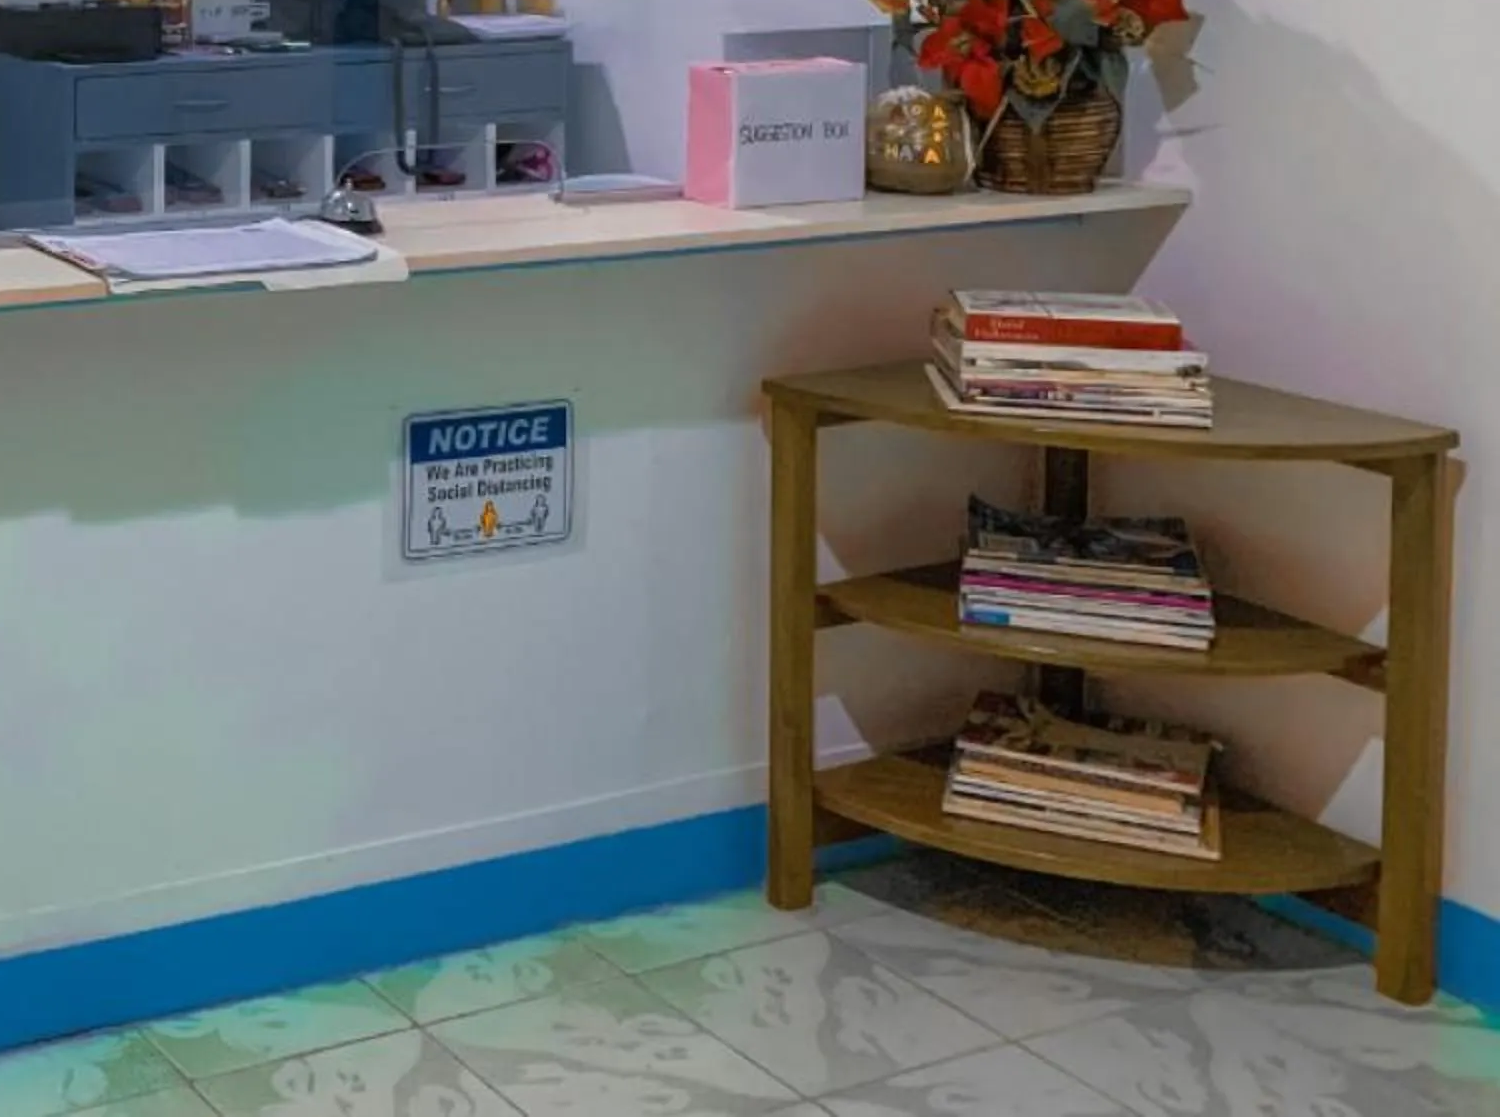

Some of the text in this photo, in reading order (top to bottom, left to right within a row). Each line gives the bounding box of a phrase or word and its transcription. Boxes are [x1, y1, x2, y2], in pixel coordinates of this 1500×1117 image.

[428, 415, 552, 455] NOTICE
[426, 454, 553, 481] We Are Practicing
[428, 475, 553, 503] Social Distancing
